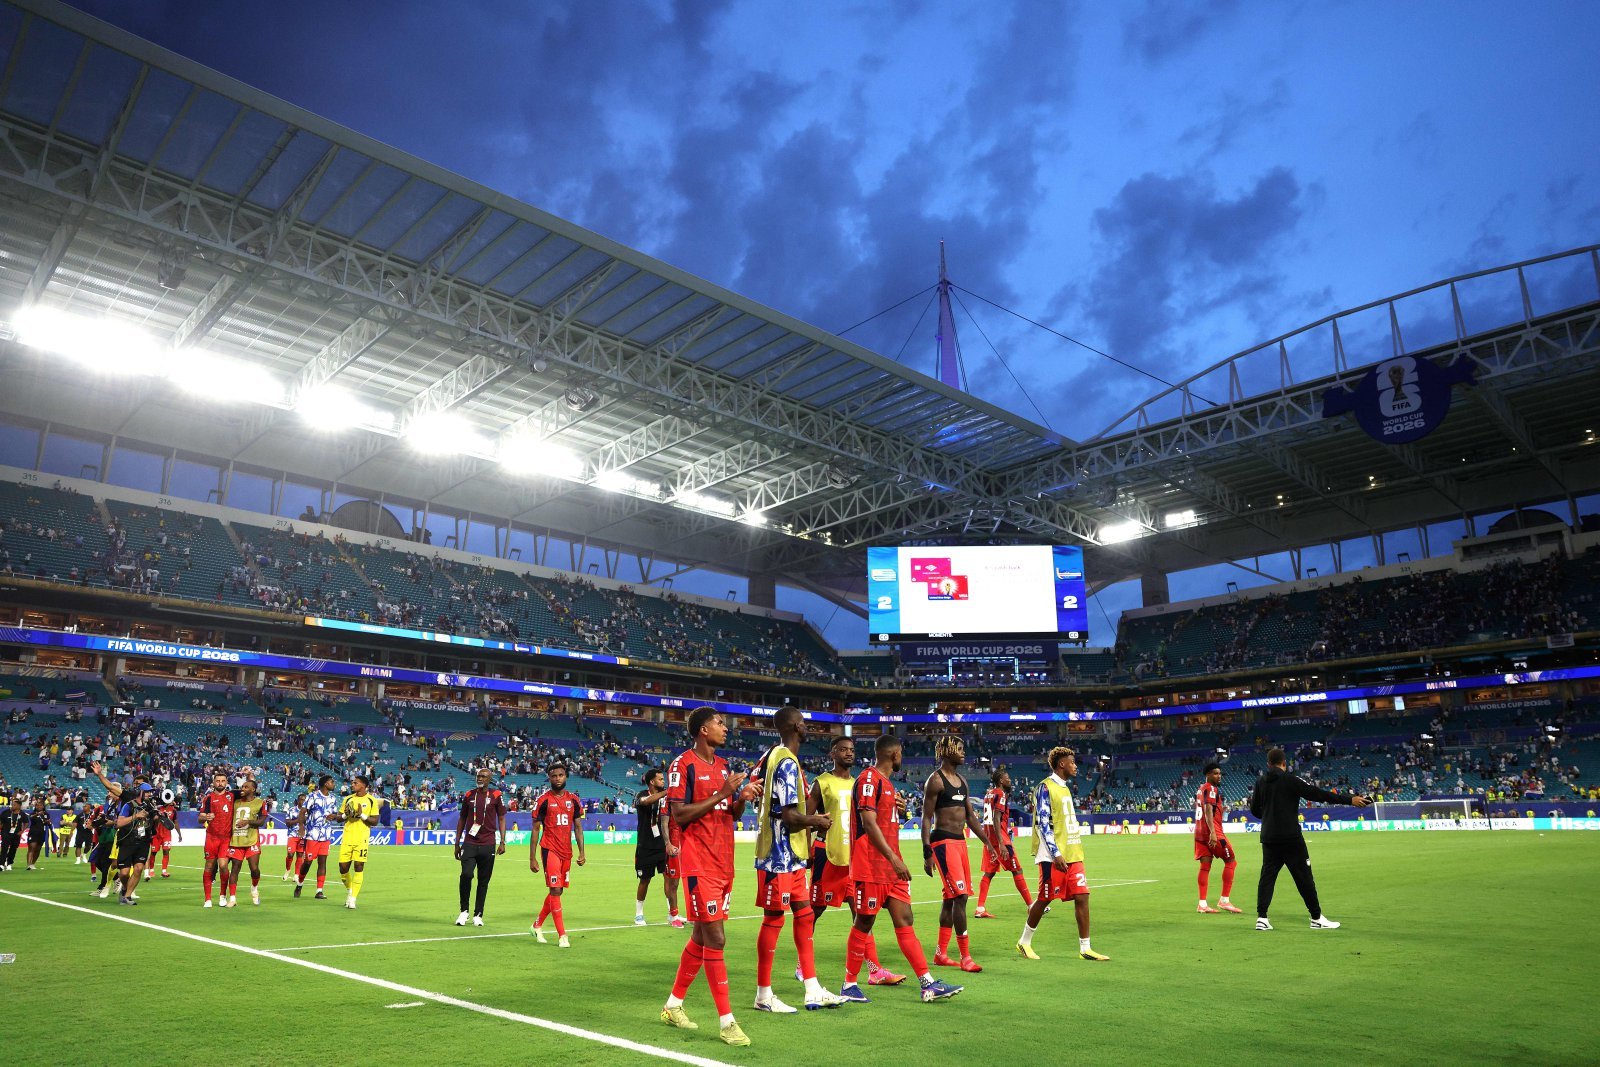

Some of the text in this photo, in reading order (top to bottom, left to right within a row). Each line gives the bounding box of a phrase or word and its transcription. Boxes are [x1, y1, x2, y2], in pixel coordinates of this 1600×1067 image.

[1392, 401, 1411, 411] FIFA
[1382, 412, 1424, 426] WORLD CUP
[1383, 419, 1425, 435] 2026
[22, 472, 38, 482] 315
[158, 497, 172, 506] 316
[276, 519, 288, 527] 317
[877, 597, 892, 609] 2
[1063, 595, 1078, 609] 2
[107, 640, 240, 661] FIFA WORLD CUP 2026
[917, 645, 1043, 656] FIFA WORLD CUP 2026
[361, 666, 393, 677] MIAMI
[1426, 680, 1457, 690] MIAMI
[660, 698, 683, 706] MIAMI
[1257, 697, 1284, 706] WORLD
[1300, 693, 1327, 702] 2026
[392, 700, 407, 708] FIFA
[433, 703, 447, 711] CUP
[1480, 703, 1506, 711] WORLD
[222, 804, 229, 812] 4
[556, 814, 568, 826] 16
[1551, 818, 1600, 830] Hise
